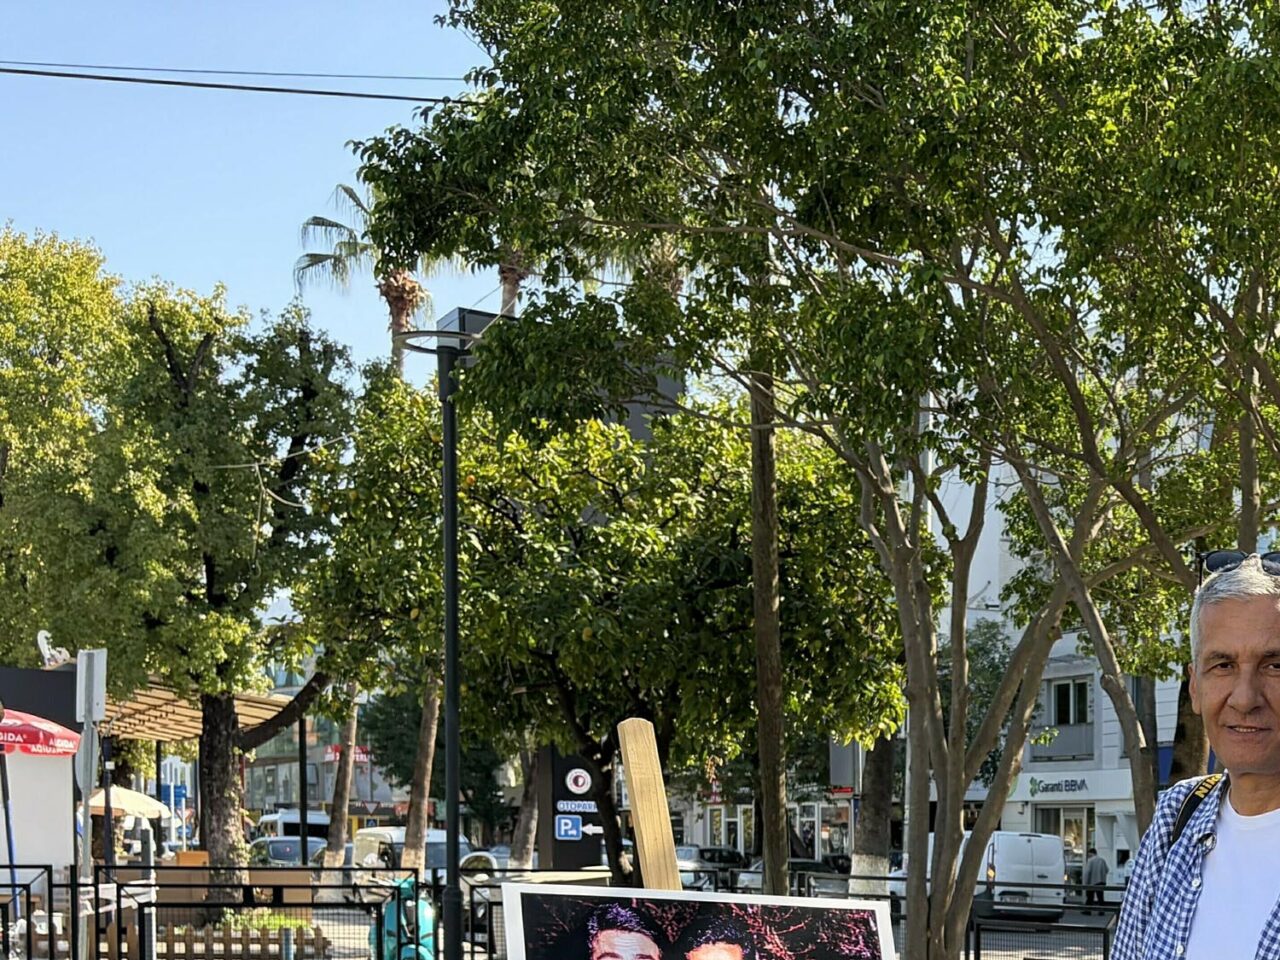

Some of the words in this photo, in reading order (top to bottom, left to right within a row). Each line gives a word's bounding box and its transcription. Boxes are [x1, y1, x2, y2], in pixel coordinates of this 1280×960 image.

[1038, 780, 1063, 793] Garanti
[1064, 778, 1089, 792] BBVA
[560, 818, 572, 836] P
